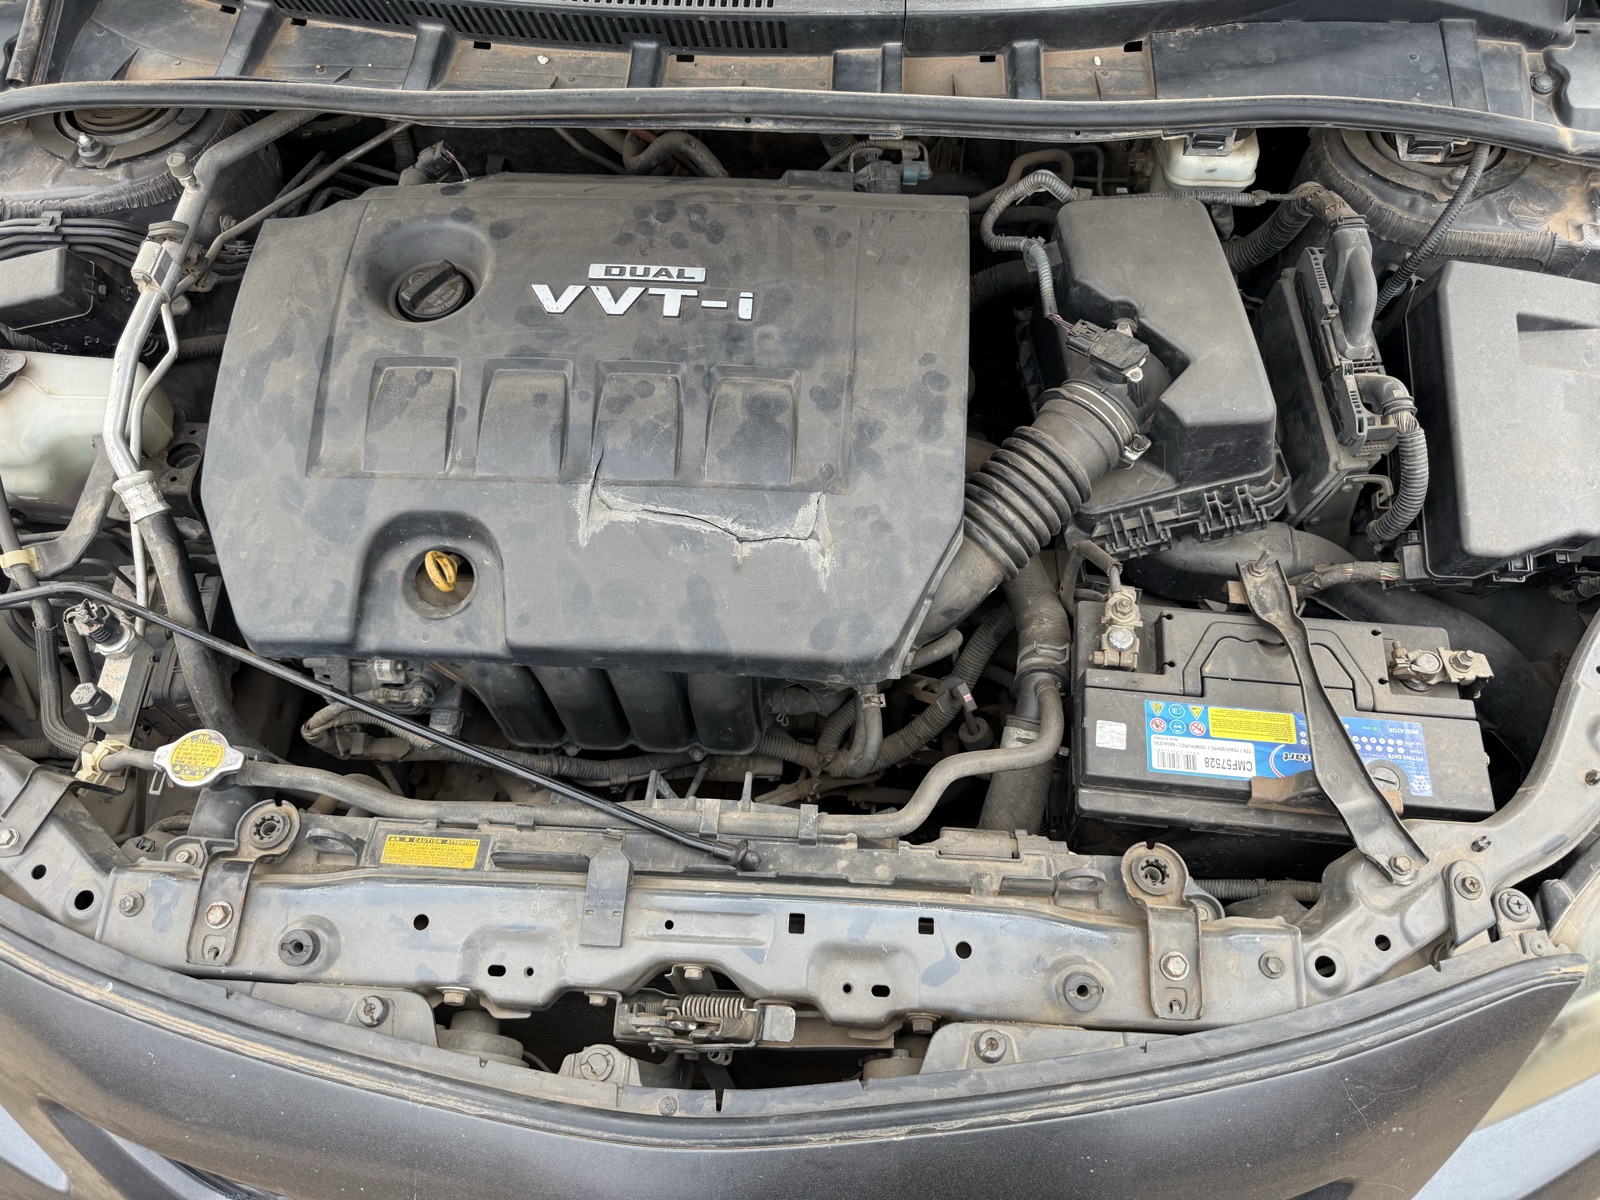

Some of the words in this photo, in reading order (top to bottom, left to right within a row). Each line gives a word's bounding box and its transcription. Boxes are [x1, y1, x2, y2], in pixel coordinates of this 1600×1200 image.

[604, 265, 696, 280] DUAL
[531, 284, 754, 320] VVT-i
[1204, 757, 1253, 772] CMF57528
[1282, 752, 1312, 763] tart
